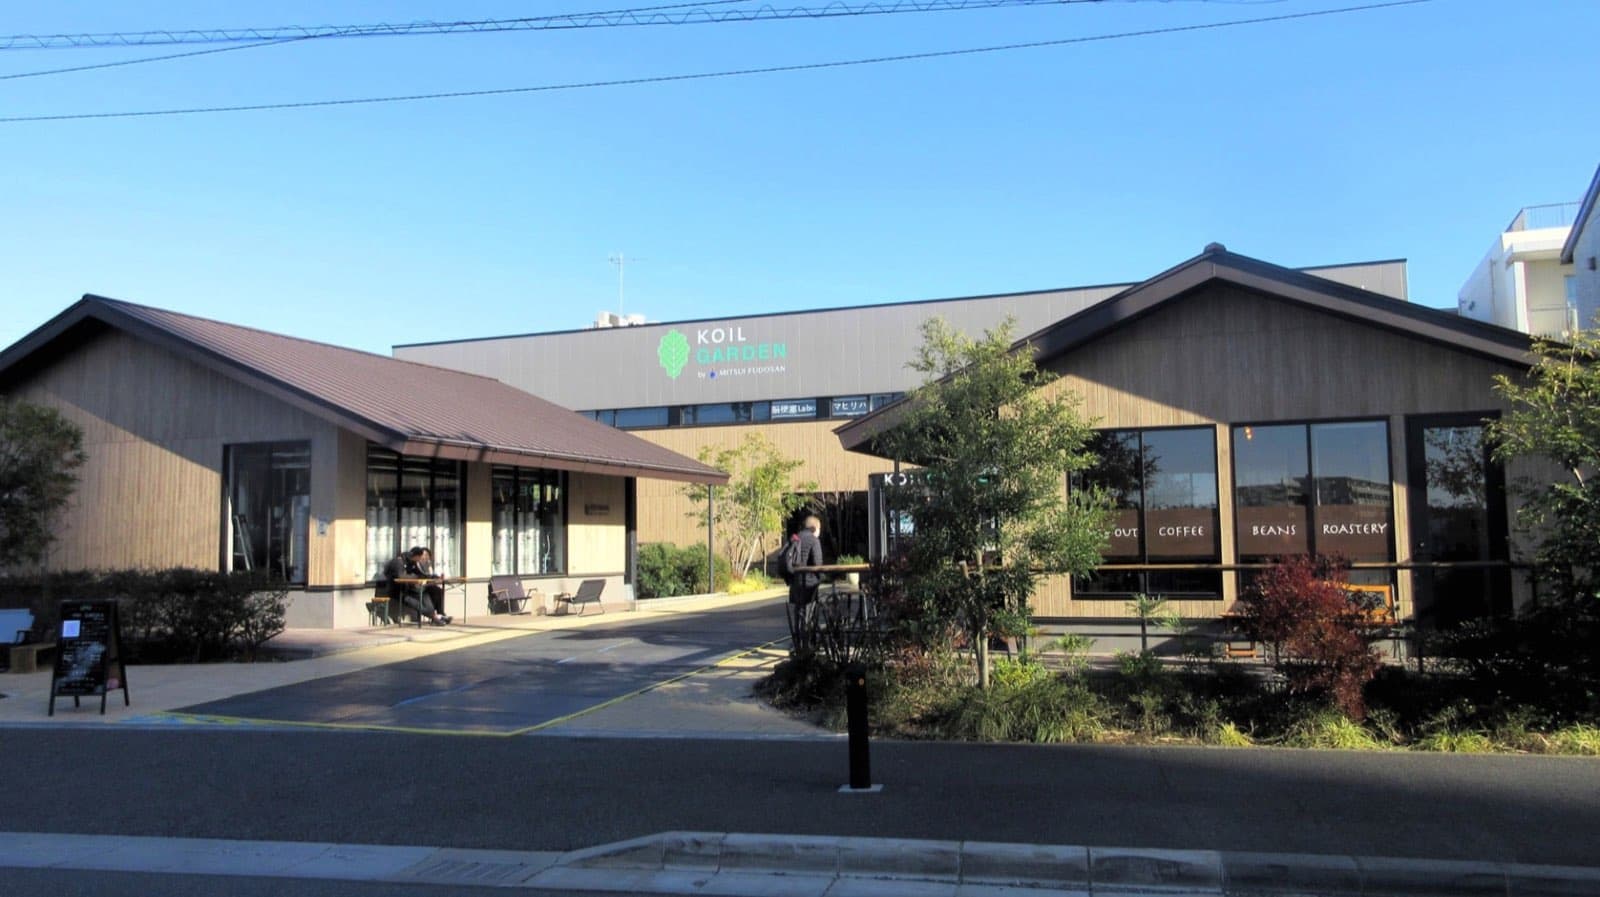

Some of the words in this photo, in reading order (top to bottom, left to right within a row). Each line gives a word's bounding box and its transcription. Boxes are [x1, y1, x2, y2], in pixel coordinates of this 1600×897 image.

[697, 327, 747, 344] KOIL
[696, 342, 787, 365] GARDEN
[697, 371, 706, 379] by
[719, 369, 746, 377] MITSUI
[747, 365, 786, 375] FUDOSAN
[1114, 527, 1138, 537] OUT
[1158, 526, 1205, 537] COFFEE
[1252, 524, 1297, 536] BEANS
[1322, 522, 1388, 535] ROASTERY
